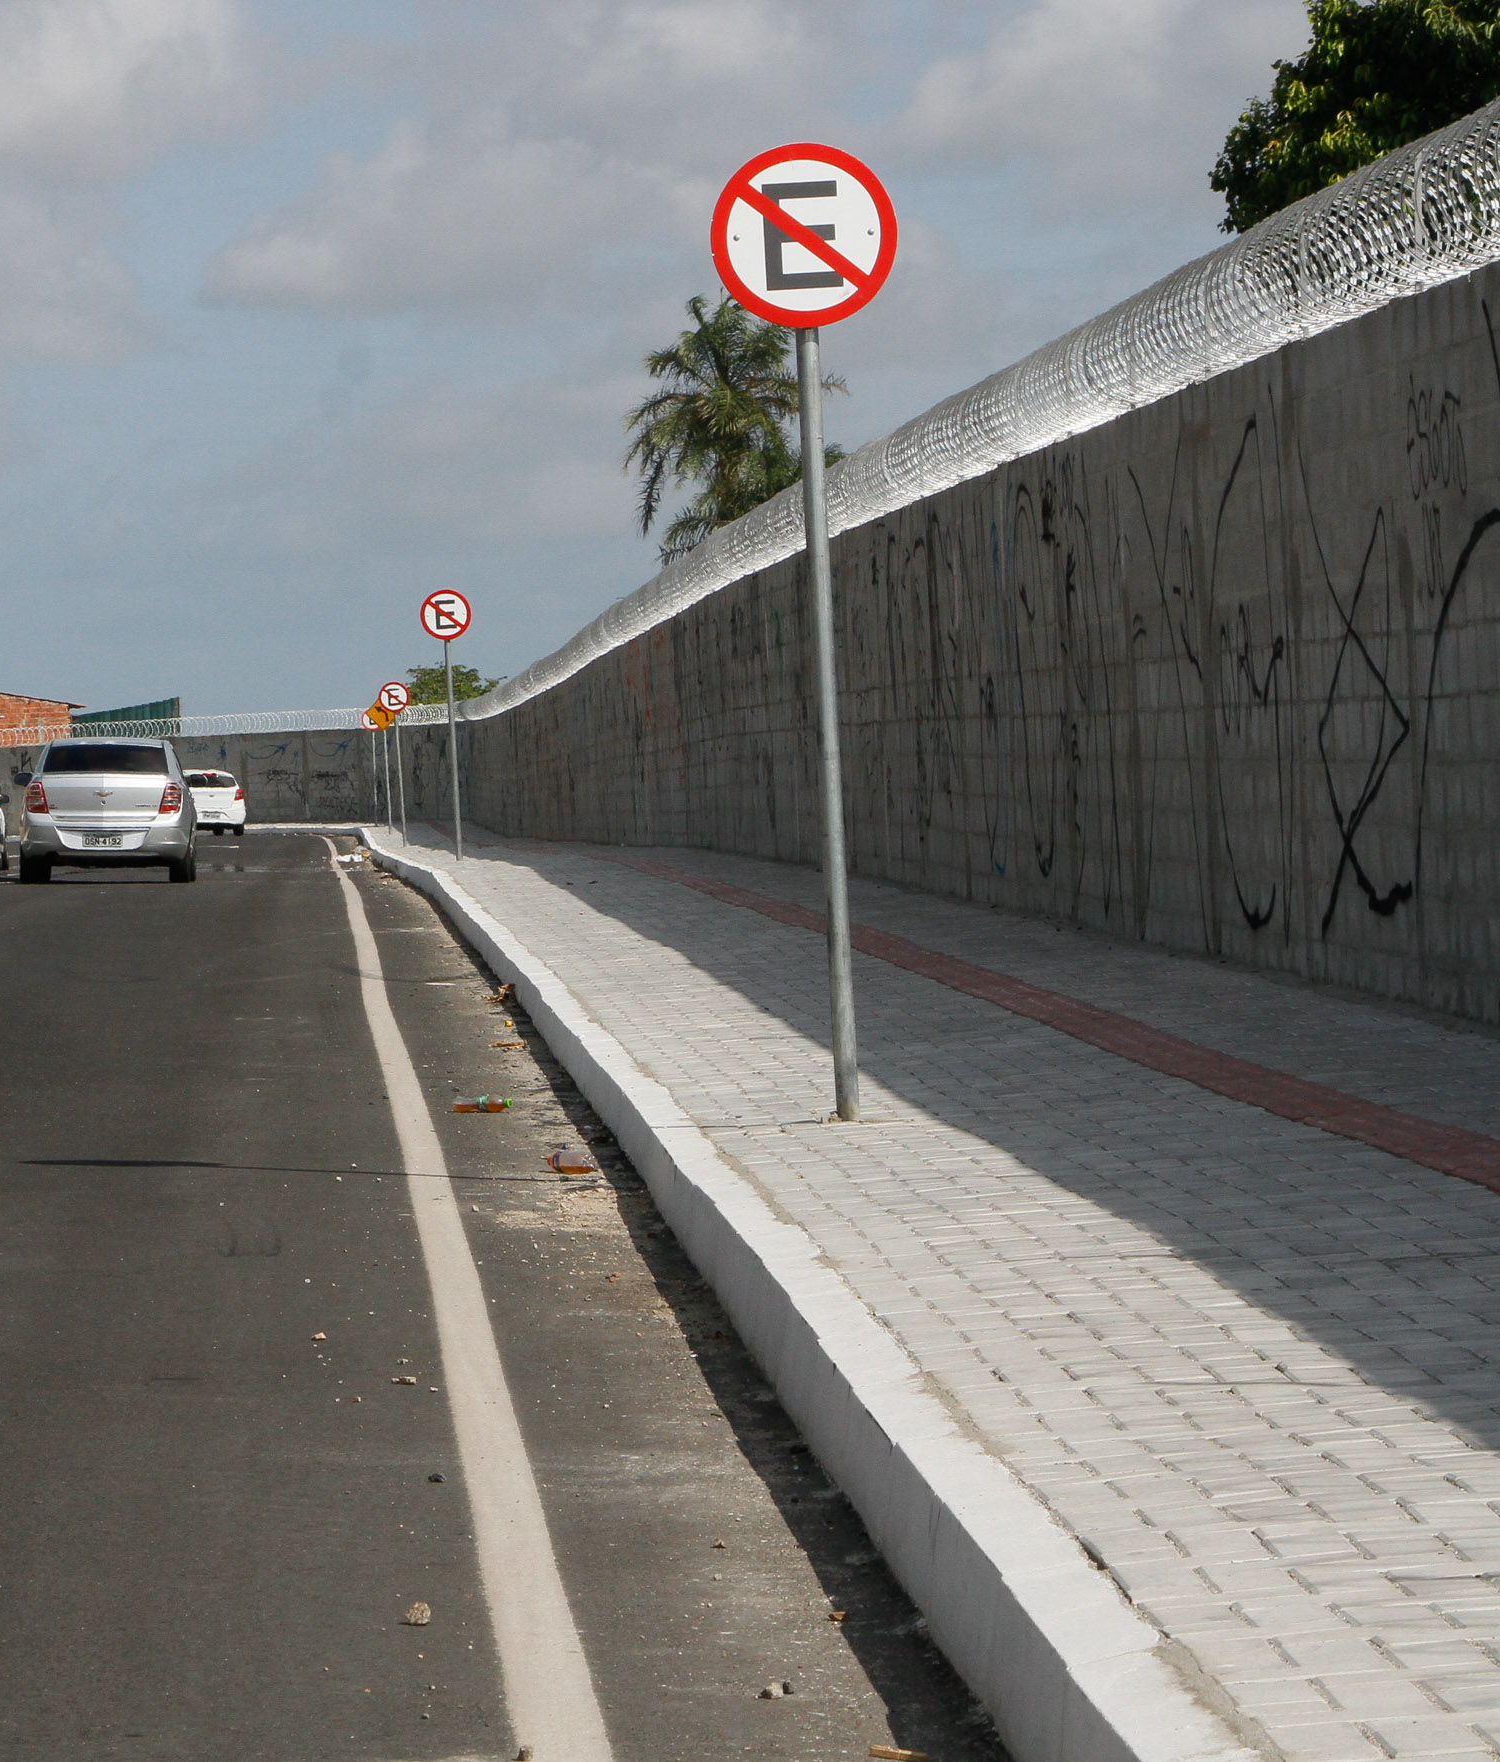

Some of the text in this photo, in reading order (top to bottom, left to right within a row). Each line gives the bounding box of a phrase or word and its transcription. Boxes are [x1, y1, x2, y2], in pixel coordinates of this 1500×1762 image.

[762, 180, 844, 291] E
[435, 600, 457, 630] E
[387, 688, 401, 706] E
